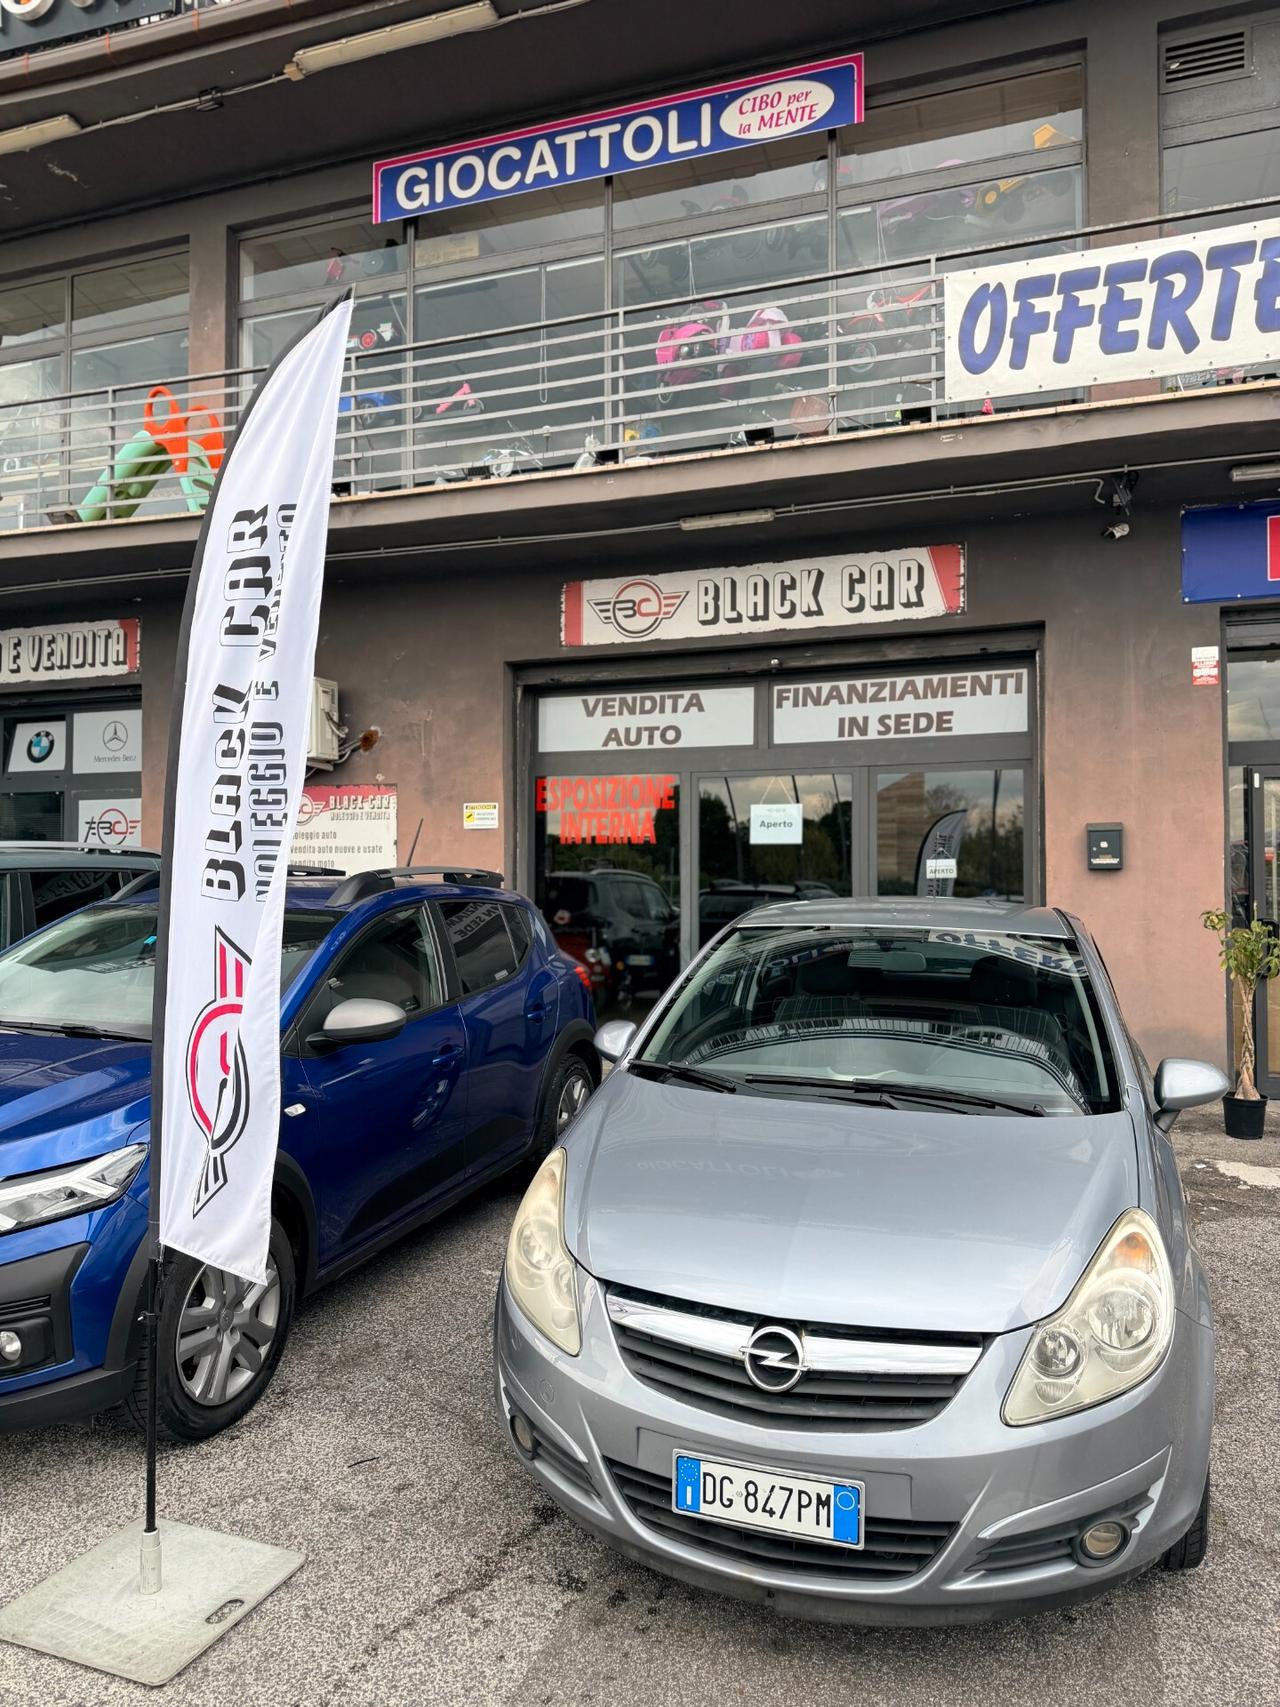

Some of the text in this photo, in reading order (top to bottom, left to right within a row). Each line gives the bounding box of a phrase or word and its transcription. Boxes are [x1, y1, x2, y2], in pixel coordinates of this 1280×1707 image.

[738, 88, 812, 116] CIBO per
[738, 102, 819, 136] la MENTE
[396, 102, 711, 211] GIOCATTOLI
[698, 567, 824, 626] BLACK
[840, 558, 924, 614] CAR
[8, 627, 128, 674] E VENDITA
[201, 504, 273, 903] BLACK CAR
[581, 692, 706, 718] VENDITA
[775, 671, 1024, 709] FINANZIAMENTI
[602, 725, 682, 749] AUTO
[838, 710, 954, 738] IN SEDE
[329, 795, 365, 810] BLACK
[535, 775, 676, 812] ESPOSIZIONE
[292, 831, 337, 841] oleggio auto
[560, 811, 657, 845] INTERNA
[760, 820, 793, 829] Aperto
[318, 845, 334, 854] auto
[335, 846, 356, 854] nuove
[363, 845, 383, 854] usate
[702, 1471, 734, 1509] DG
